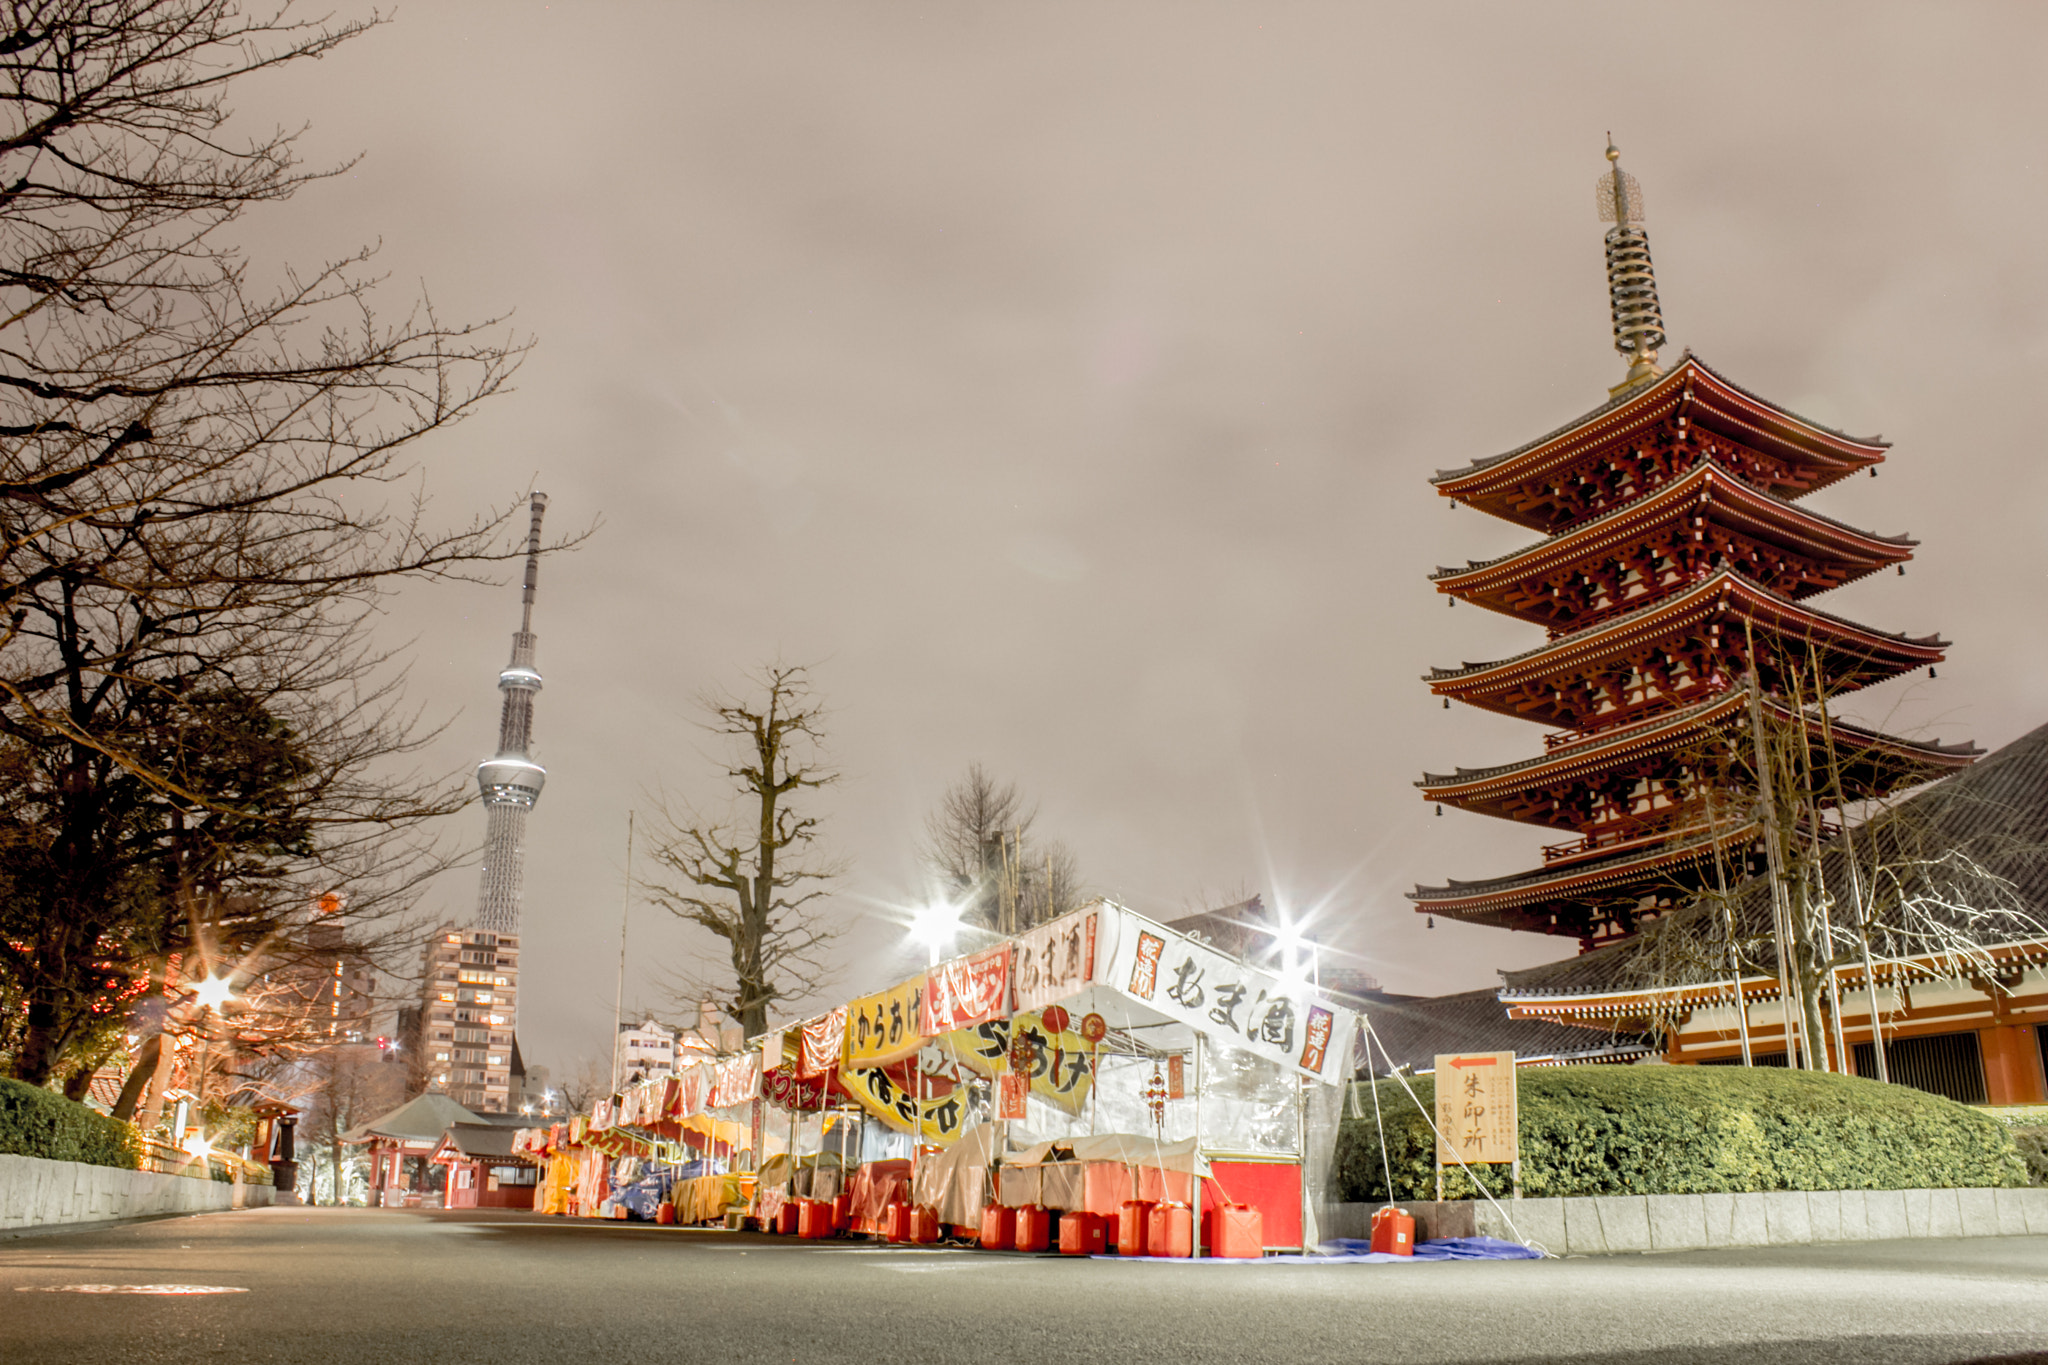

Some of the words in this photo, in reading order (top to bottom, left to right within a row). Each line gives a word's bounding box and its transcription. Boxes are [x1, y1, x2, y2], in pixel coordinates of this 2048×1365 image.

[1166, 956, 1296, 1054] あま酒
[966, 1020, 1094, 1094] らあげ
[1463, 1072, 1487, 1154] 朱印所
